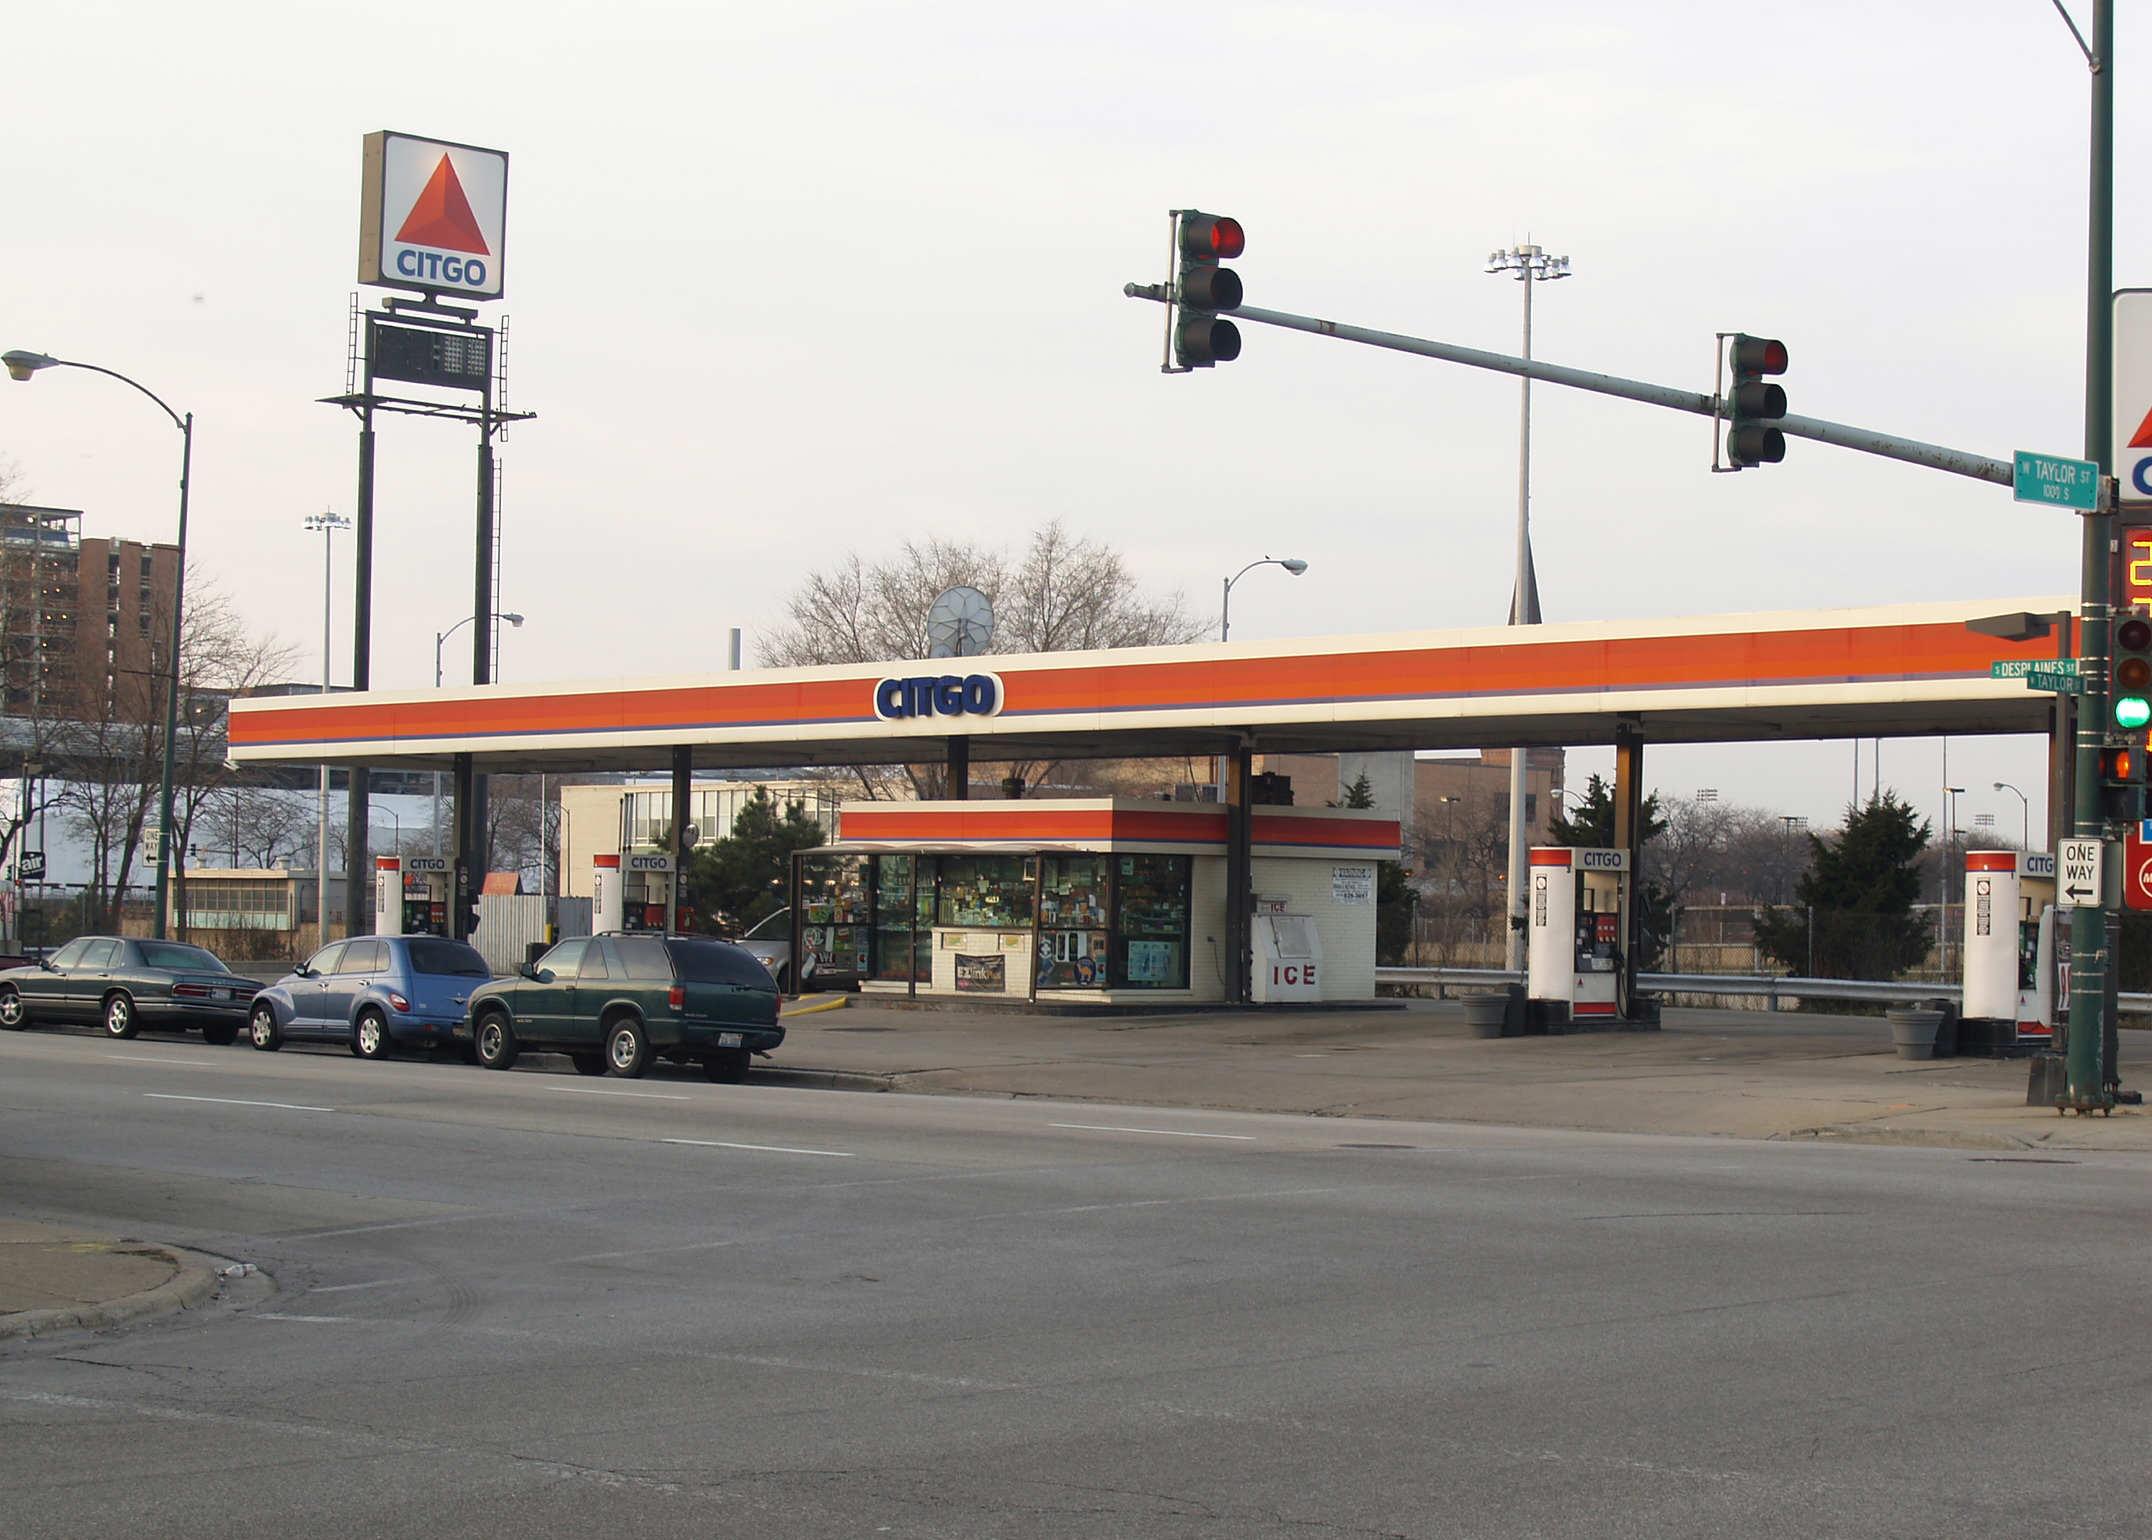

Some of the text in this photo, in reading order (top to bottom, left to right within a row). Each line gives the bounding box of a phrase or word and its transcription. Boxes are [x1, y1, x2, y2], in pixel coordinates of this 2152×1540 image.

[397, 249, 486, 286] CITGO
[2035, 460, 2076, 485] TAYLOR
[2080, 471, 2091, 484] ST
[2063, 487, 2070, 501] S
[2037, 674, 2074, 691] TAYLOR
[877, 674, 996, 718] CITGO
[1584, 852, 1622, 867] CITGO
[2066, 845, 2095, 861] ONE
[410, 859, 445, 869] CITGO
[631, 856, 668, 868] CITGO
[2027, 856, 2054, 872] CITG
[2066, 865, 2095, 880] WAY
[1270, 903, 1285, 912] ICE
[1273, 964, 1316, 986] ICE
